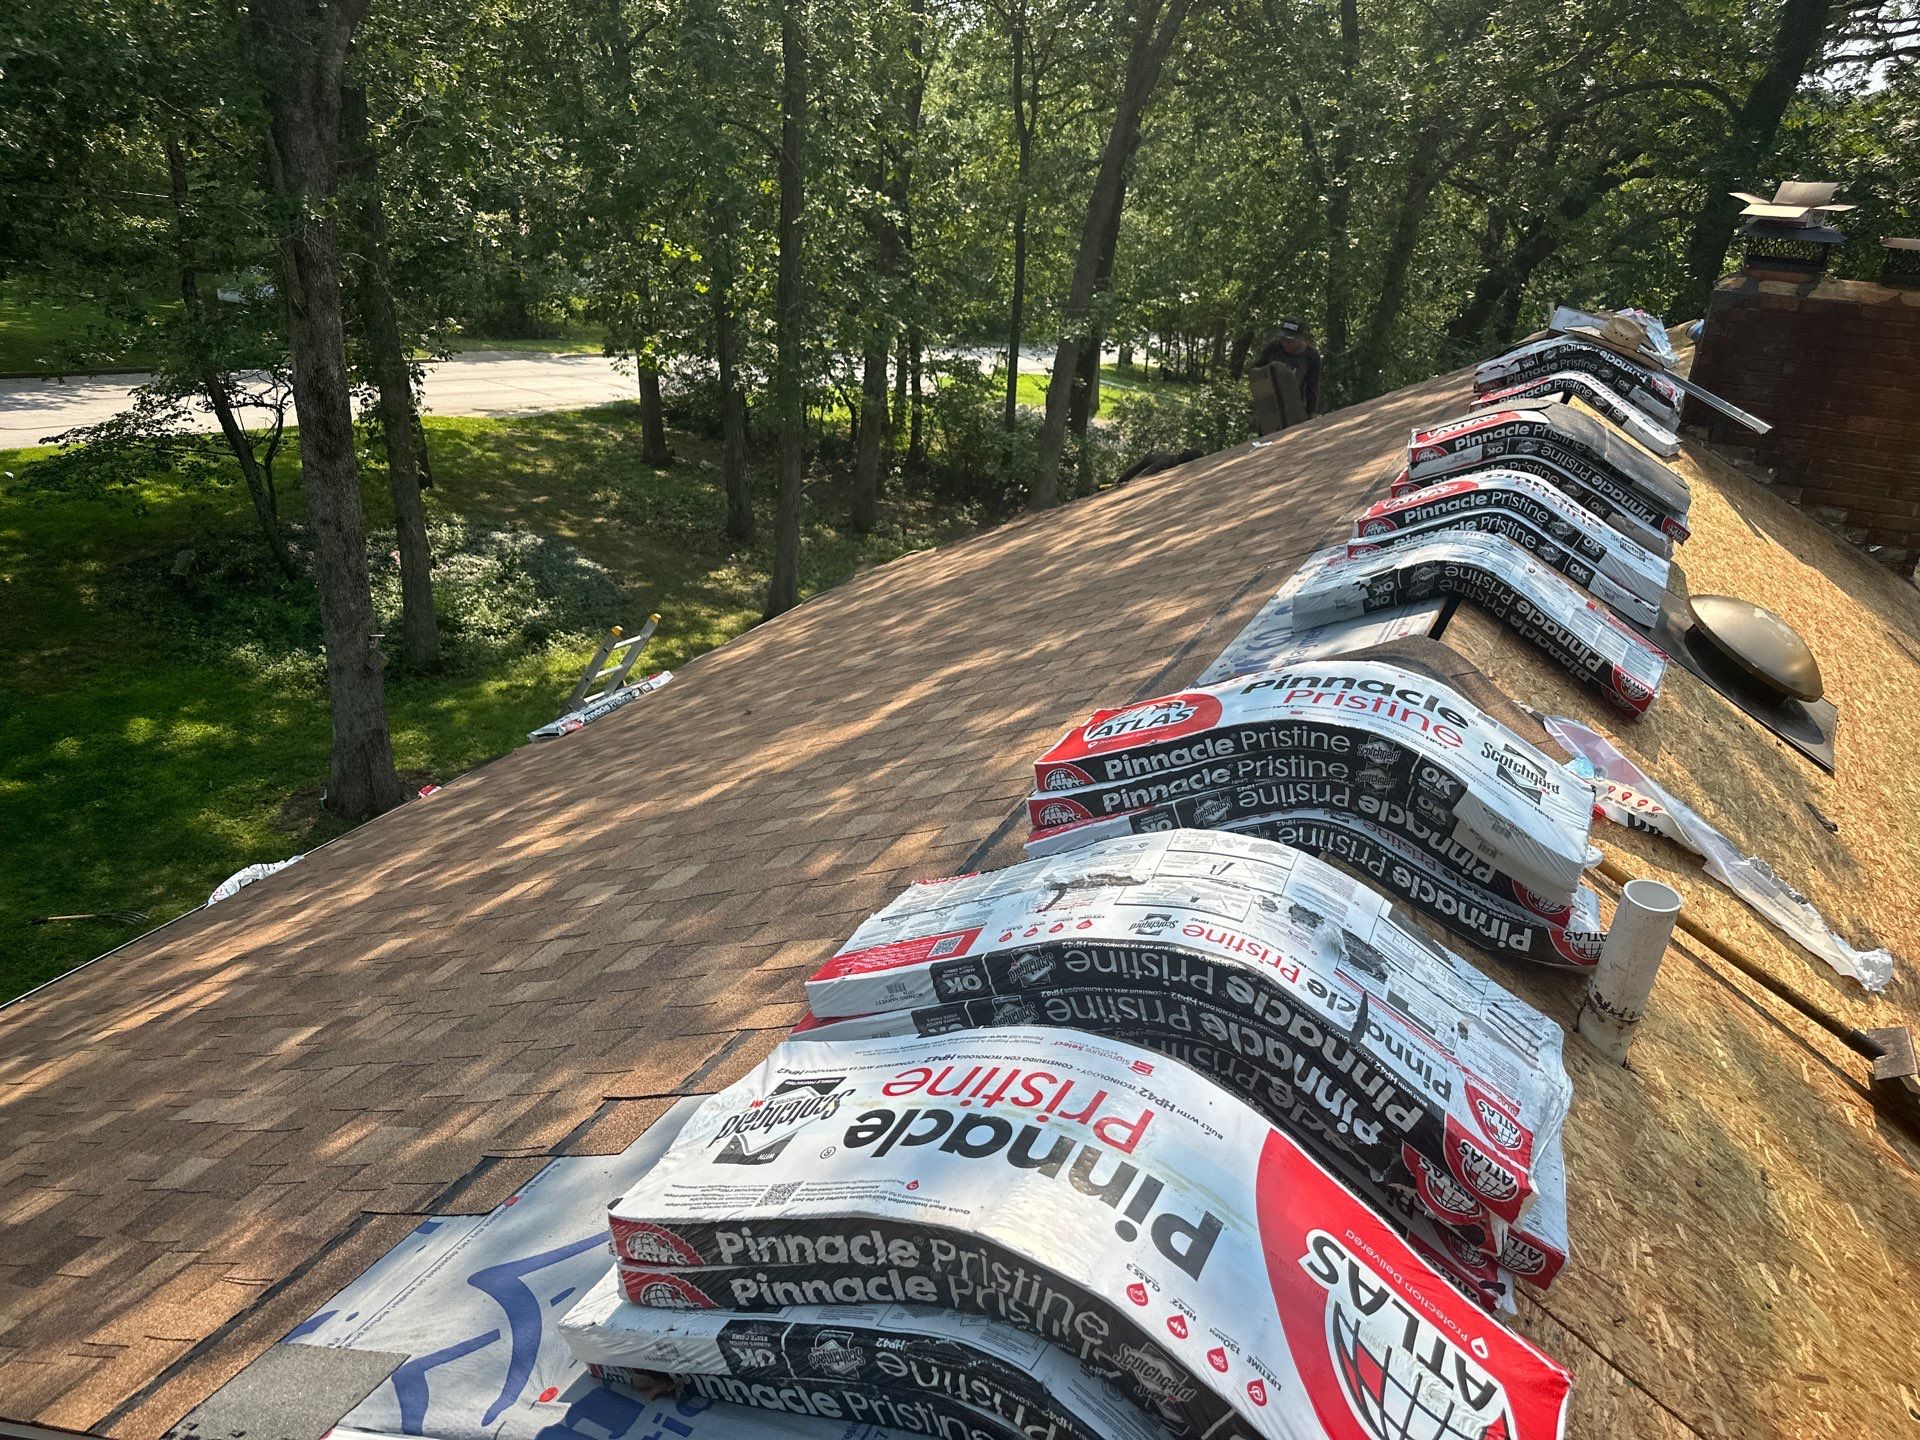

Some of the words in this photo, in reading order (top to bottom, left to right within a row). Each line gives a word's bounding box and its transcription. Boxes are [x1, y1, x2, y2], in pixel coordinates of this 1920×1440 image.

[1506, 361, 1558, 384] Pinnacle
[1559, 359, 1598, 372] Pristine
[1554, 379, 1593, 398] Pristine
[1455, 423, 1530, 451] Pinnacle
[1510, 461, 1560, 484] Pristine
[1541, 444, 1592, 483] Pristine
[1404, 492, 1488, 524] Pinnacle
[1491, 491, 1550, 524] Pristine
[1590, 500, 1609, 515] OK
[1591, 475, 1657, 524] Pinnacle
[1480, 516, 1537, 549] Pristine
[1583, 535, 1602, 552] OK
[1445, 565, 1514, 605] Pristine
[1569, 562, 1590, 581] OK
[1370, 595, 1392, 608] OK
[1375, 580, 1395, 595] OK
[1438, 578, 1507, 618] Pristine
[1509, 614, 1591, 683] Pinnacle
[1516, 601, 1606, 673] Pinnacle
[1241, 674, 1469, 730] Pinnacle
[1088, 704, 1199, 739] ATLAS
[1283, 689, 1464, 748] Pristine
[1105, 737, 1235, 780] Pinnacle
[1240, 725, 1350, 753] Pristine
[1357, 741, 1401, 761] Scotchgard
[1102, 767, 1231, 812] Pinnacle
[1237, 755, 1350, 779] Pristine
[1354, 770, 1398, 788] Scotchgard
[1420, 765, 1459, 796] OK
[1481, 742, 1560, 795] Scotchgard
[1049, 779, 1086, 791] ATLAS
[1239, 783, 1350, 808] Pristine
[1044, 813, 1082, 826] ATLAS
[1193, 794, 1233, 824] Scotchgard
[1275, 816, 1296, 828] HP42
[1417, 795, 1448, 823] OK
[1278, 823, 1386, 877] Pristine
[1358, 796, 1496, 884] Pinnacle
[1392, 866, 1532, 952] Pinnacle
[1128, 919, 1178, 930] Scotchgard
[1060, 940, 1086, 948] HP42
[1182, 924, 1301, 985] Pristine
[943, 973, 984, 993] OK
[1008, 952, 1056, 985] Scotchgard
[1064, 950, 1214, 995] Pristine
[1040, 987, 1062, 997] HP42
[1046, 996, 1192, 1032] Pristine
[1052, 1037, 1084, 1054] Select
[1226, 974, 1424, 1133] Pinnacle
[1305, 976, 1453, 1103] Pinnacle
[924, 1053, 955, 1065] HP42
[1021, 1055, 1073, 1070] CONSTRUIDO
[1083, 1044, 1131, 1066] Signature
[776, 1066, 804, 1075] HP42
[1080, 1067, 1136, 1097] TECHNOLOGY
[1200, 1012, 1384, 1145] Pinnacle
[1372, 1060, 1398, 1085] HP42
[882, 1066, 1155, 1155] Pristine
[1138, 1085, 1176, 1114] HP42
[707, 1088, 856, 1148] Scotchgard
[1176, 1107, 1203, 1127] WITH
[1203, 1122, 1224, 1140] BUILT
[1477, 1099, 1520, 1135] ATLAS
[1459, 1139, 1516, 1187] ATLAS
[843, 1108, 1225, 1282] Pinnacle
[929, 1202, 947, 1210] Start
[947, 1205, 970, 1215] Quick
[1345, 1228, 1402, 1284] Delivered
[1502, 1235, 1543, 1264] ATL
[424, 1251, 458, 1281] dependent
[1133, 1268, 1161, 1293] CLASS
[716, 1227, 920, 1267] Pinnacle
[930, 1238, 1110, 1345] Pristine
[730, 1268, 937, 1306] Pinnacle
[1169, 1298, 1197, 1321] HP42
[1307, 1234, 1499, 1411] ATLAS
[1403, 1284, 1469, 1343] Protection
[730, 1347, 776, 1367] OK
[875, 1337, 906, 1351] HP42
[1112, 1344, 1198, 1402] Scotchgard
[1246, 1355, 1283, 1391] LIFETIME
